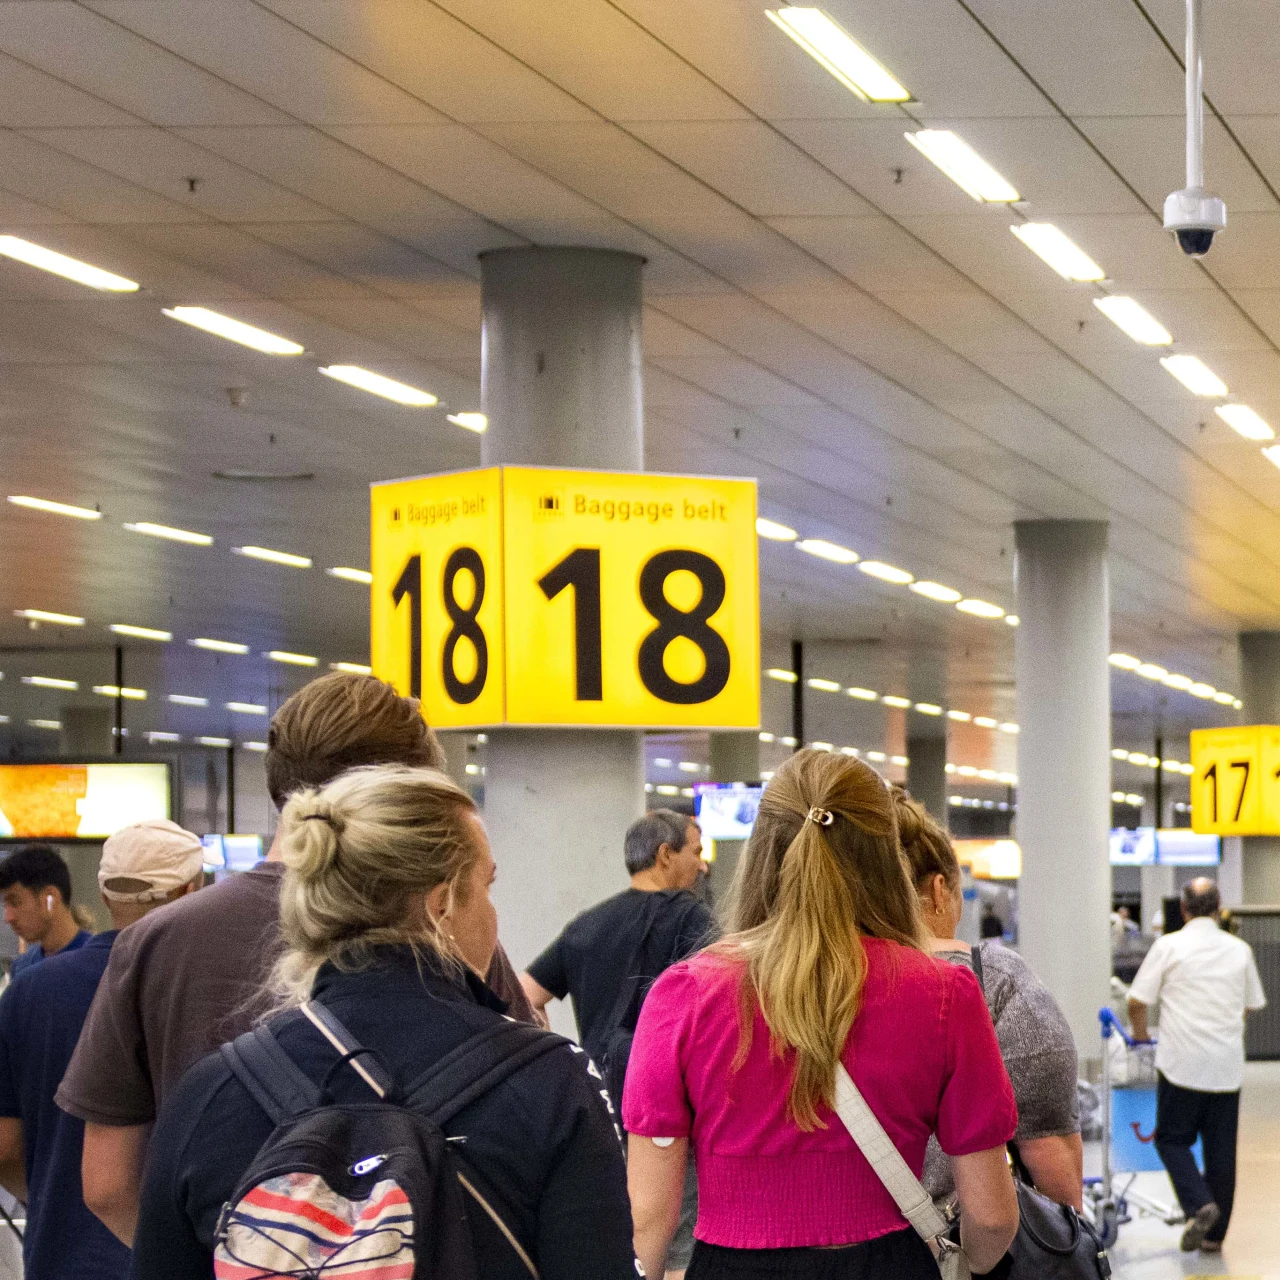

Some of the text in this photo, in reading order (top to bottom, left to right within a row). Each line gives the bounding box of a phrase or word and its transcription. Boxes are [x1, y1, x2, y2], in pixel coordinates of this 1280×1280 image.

[407, 494, 485, 526] Baggage belt
[573, 494, 729, 523] Baggage belt
[391, 546, 489, 705] 18
[537, 547, 731, 705] 18
[1203, 761, 1250, 823] 17
